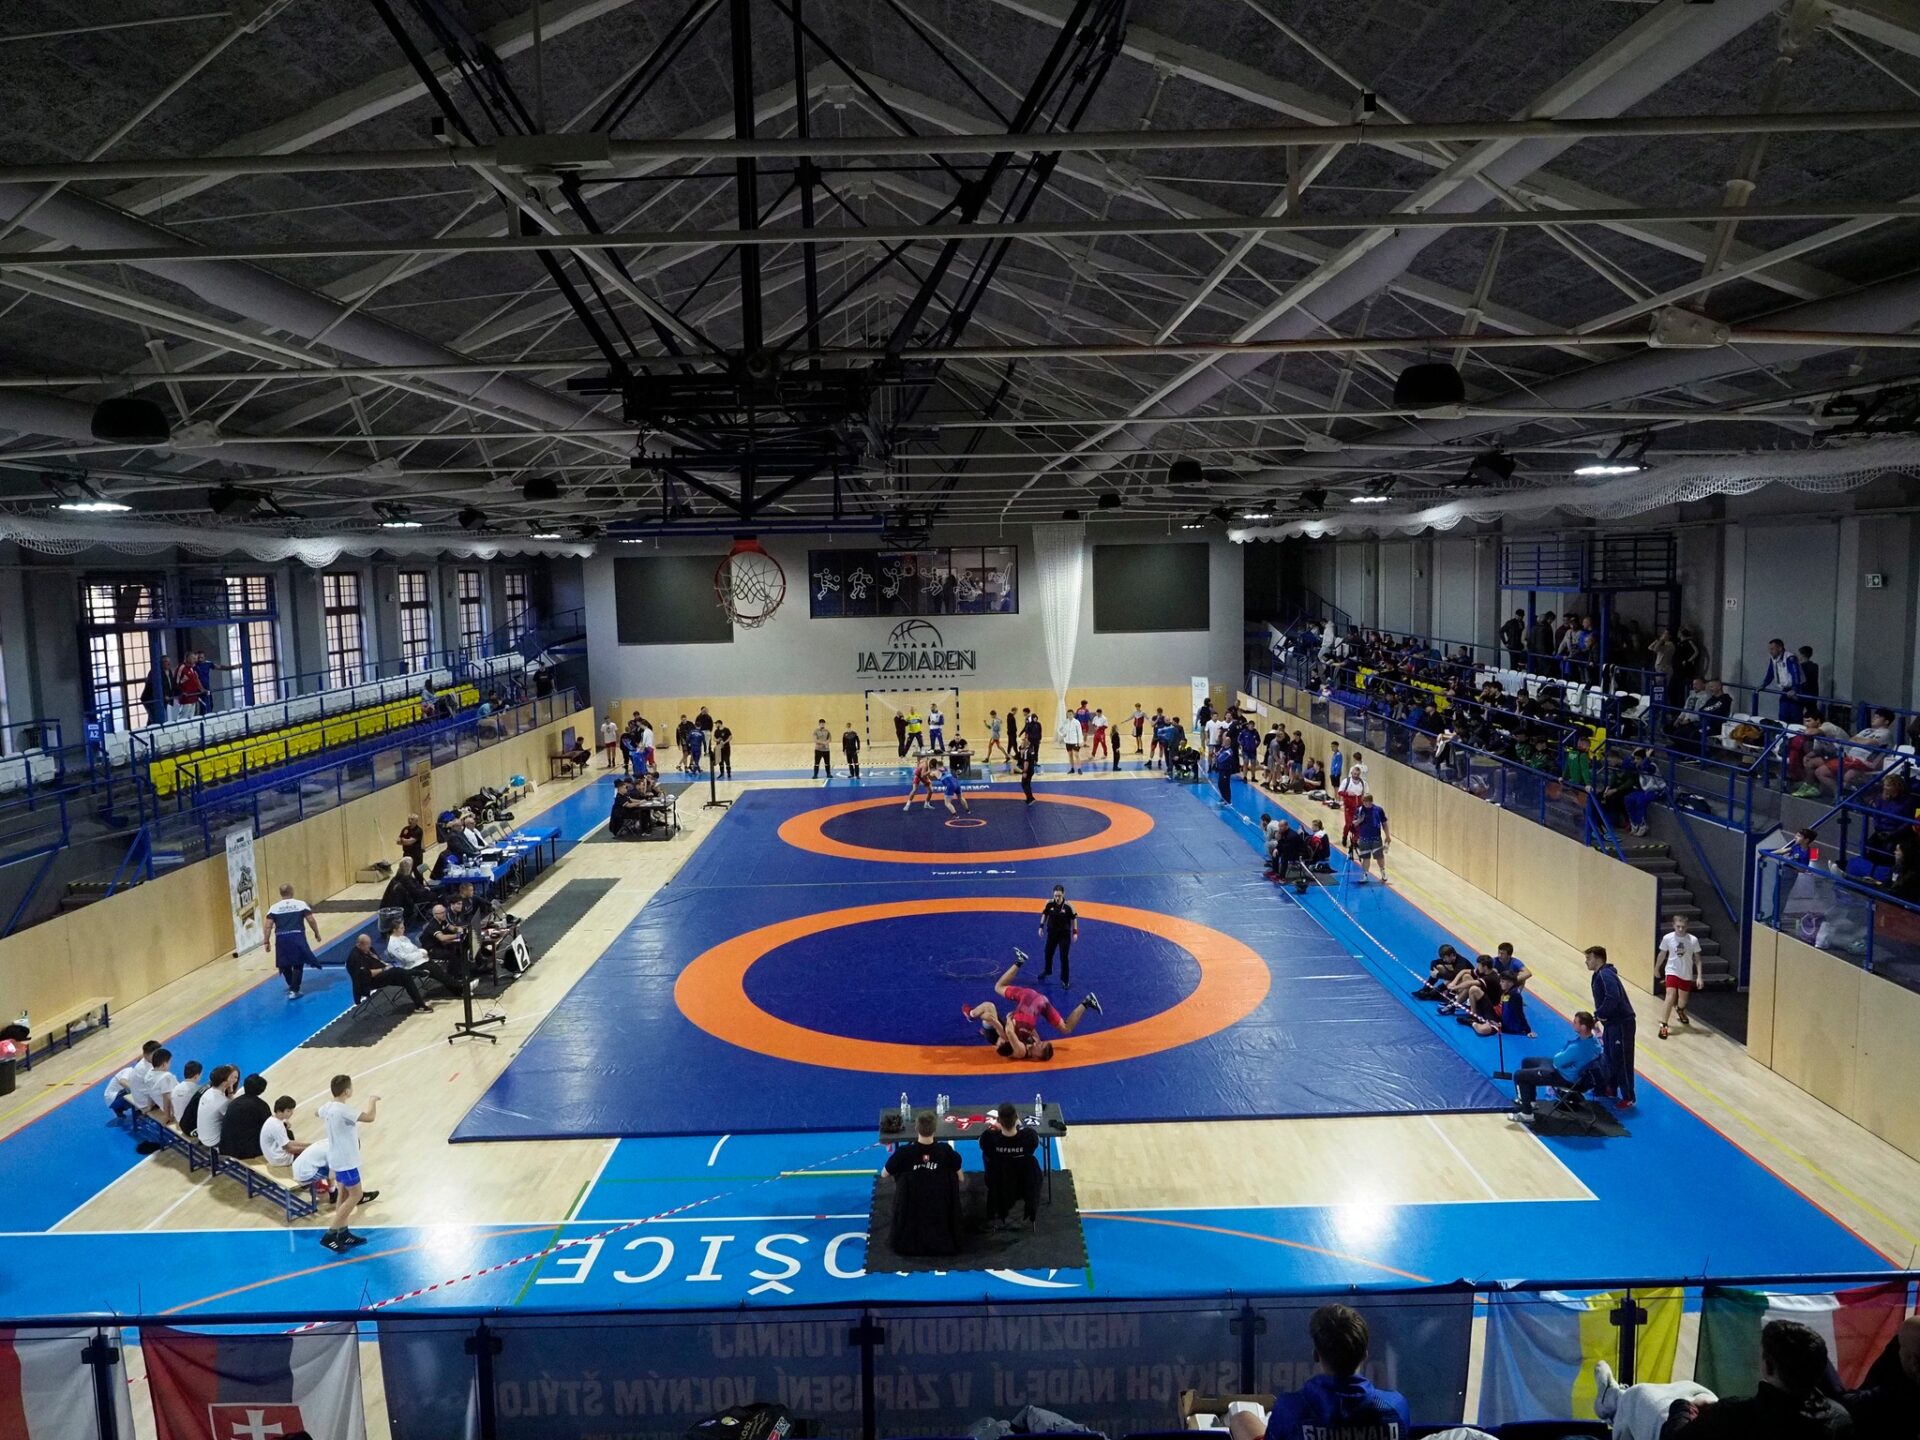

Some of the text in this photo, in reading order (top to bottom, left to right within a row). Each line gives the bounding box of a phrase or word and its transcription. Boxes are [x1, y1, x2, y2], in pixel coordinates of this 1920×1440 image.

[893, 641, 937, 649] STARÁ
[856, 650, 977, 672] JAZDIAREŇ
[517, 943, 529, 969] 2
[535, 1232, 947, 1295] OŠICE
